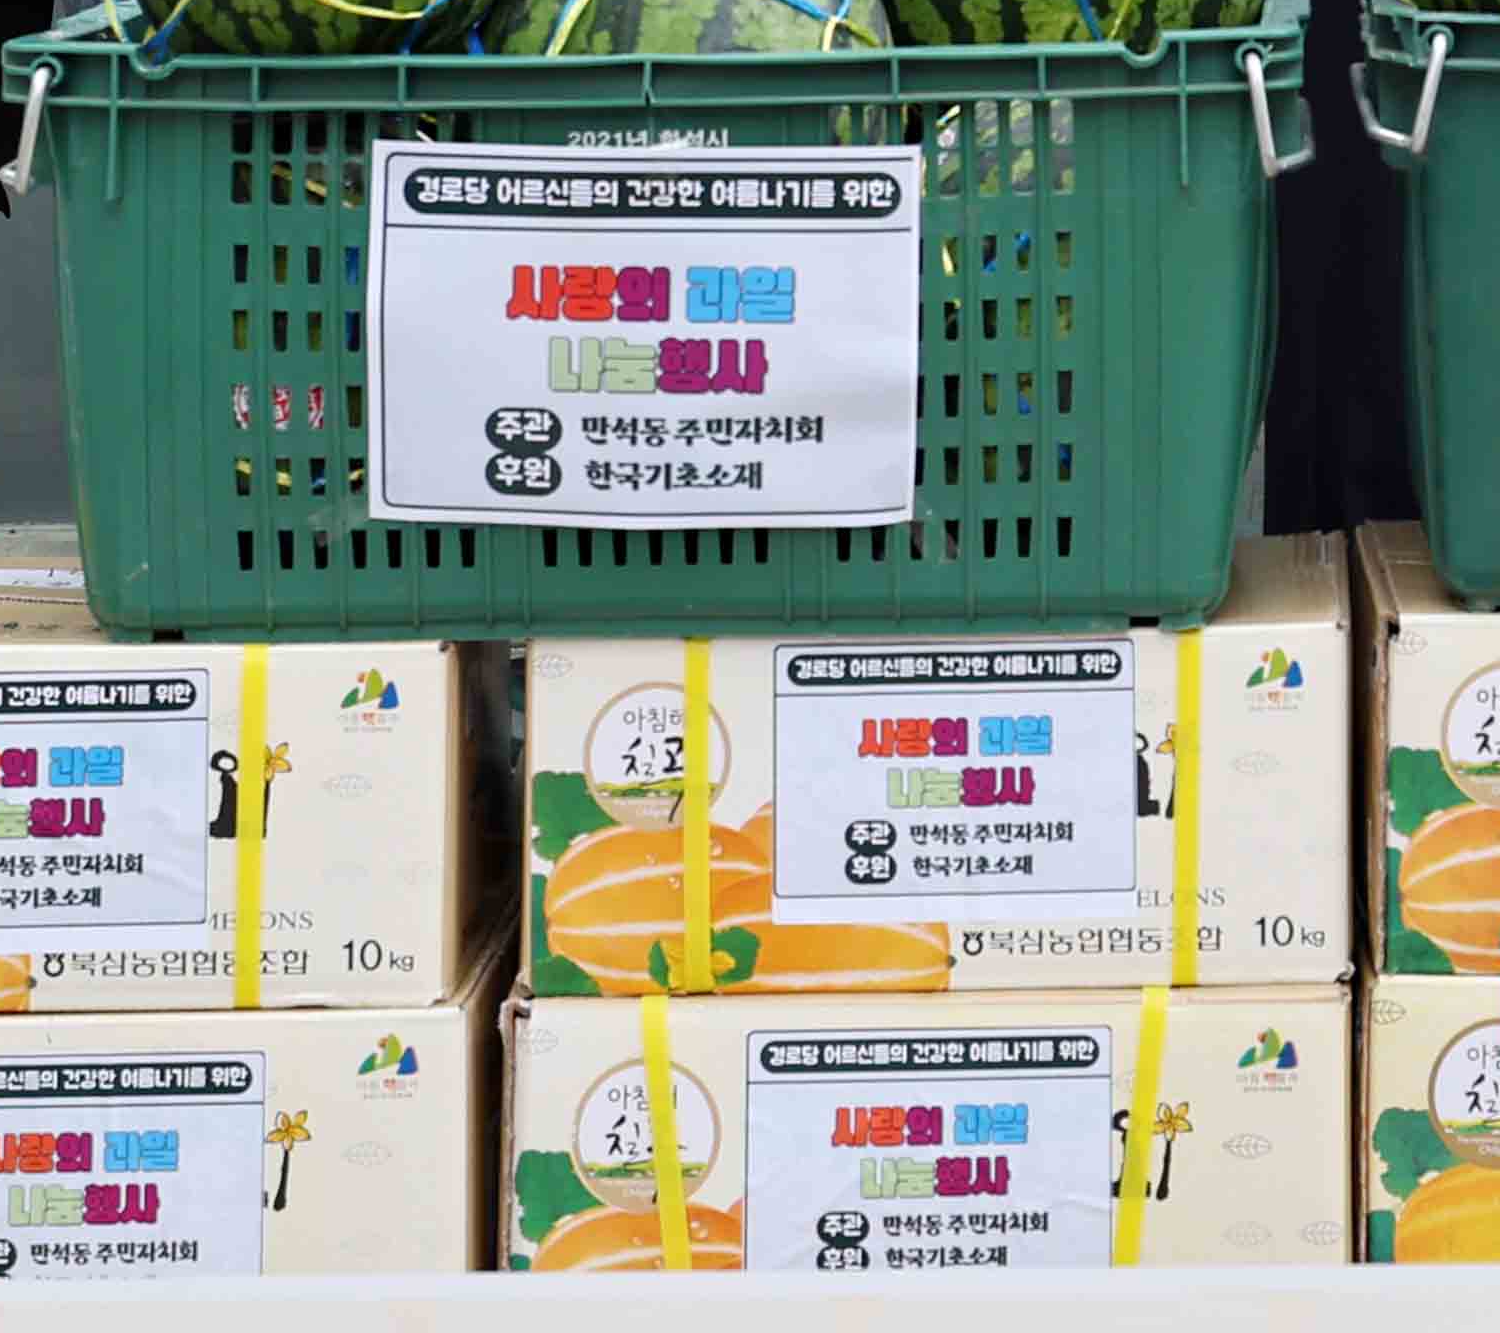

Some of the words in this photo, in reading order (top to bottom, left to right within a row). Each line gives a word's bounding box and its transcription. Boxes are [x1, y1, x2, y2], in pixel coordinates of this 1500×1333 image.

[414, 175, 490, 205] 경로당
[497, 176, 619, 207] 어르신들의
[627, 177, 703, 208] 건강한
[711, 179, 836, 208] 여름나기를
[843, 180, 894, 208] 위한
[506, 265, 670, 322] 사랑의
[686, 266, 795, 324] 과일
[548, 336, 768, 394] 나눔행사
[495, 413, 551, 440] 주관
[581, 415, 669, 446] 만석동
[674, 415, 824, 446] 주민자치회
[494, 456, 552, 489] 후원
[585, 460, 763, 492] 한국기초소재
[858, 718, 969, 757] 사랑의
[979, 715, 1052, 756] 과일
[49, 745, 125, 786] 과일
[887, 767, 1035, 808] 나눔행사
[851, 825, 890, 844] 주관
[910, 823, 968, 845] 만석동
[974, 822, 1073, 843] 주민자치회
[41, 854, 144, 876] 주민자치회
[851, 856, 890, 878] 후원
[913, 855, 1033, 876] 한국기초소재
[1255, 915, 1294, 946] 10
[1300, 926, 1325, 947] kg
[342, 939, 383, 972] 10
[389, 951, 414, 971] kg
[832, 1106, 943, 1147] 사랑의
[953, 1104, 1028, 1144] 과일
[103, 1130, 179, 1172] 과일
[860, 1155, 1010, 1199] 나눔행사
[8, 1183, 160, 1226] 나눔행사
[824, 1215, 864, 1237] 주관
[883, 1214, 942, 1237] 만석동
[948, 1212, 1049, 1235] 주민자치회
[31, 1243, 92, 1265] 만석동
[95, 1240, 198, 1263] 주민자치회
[885, 1247, 1008, 1268] 한국기초소재
